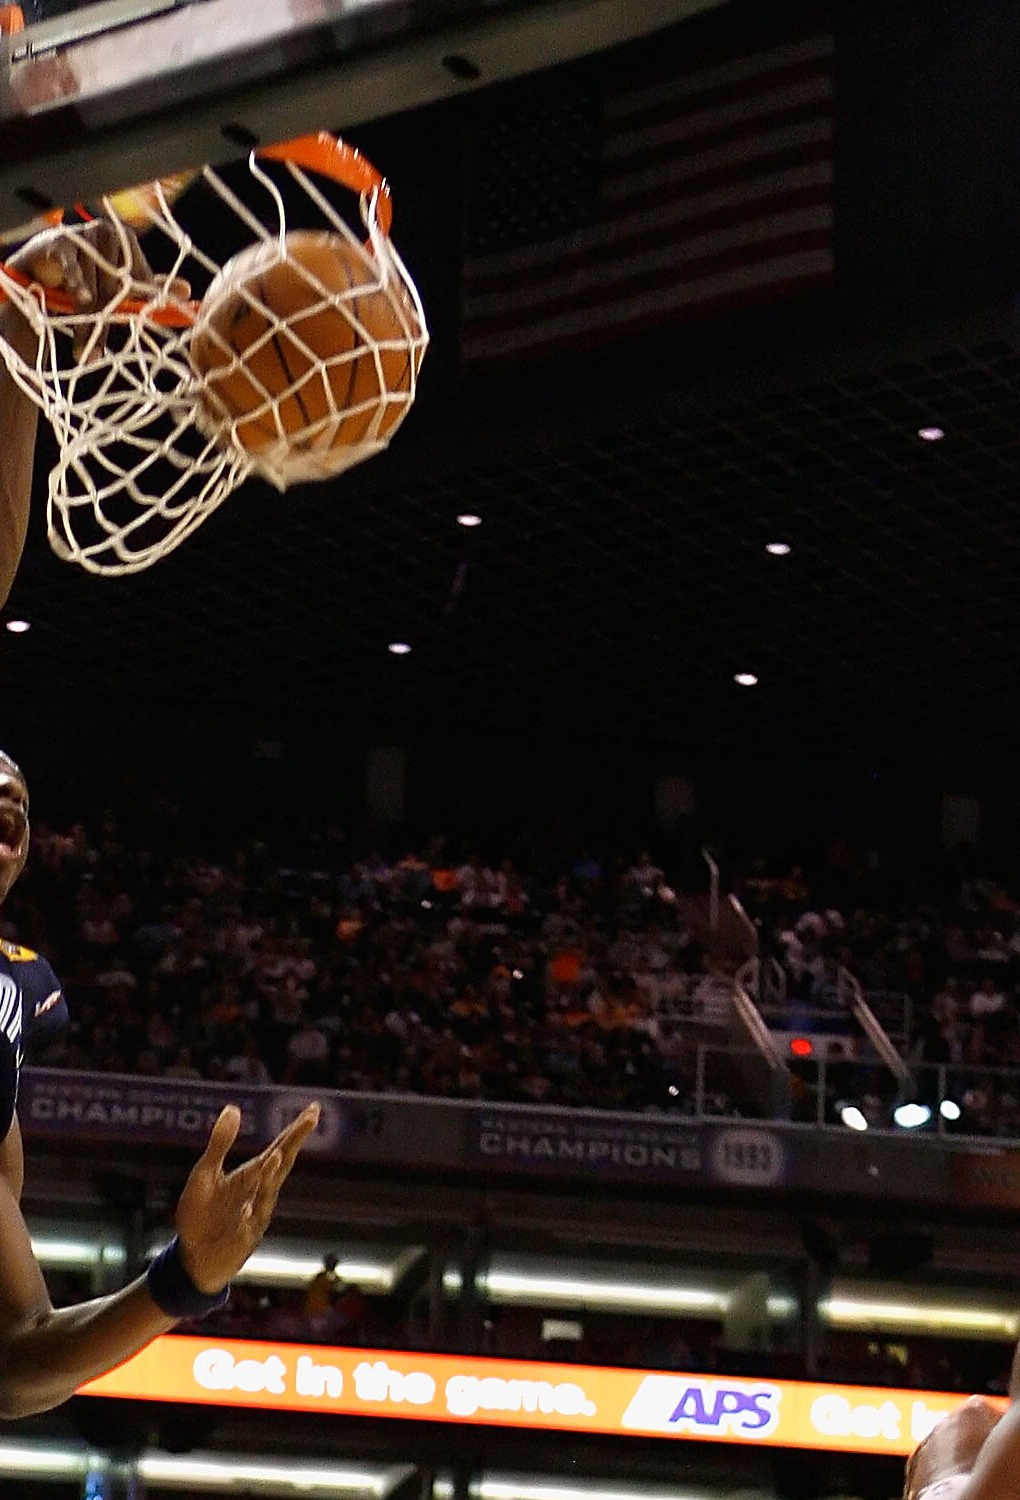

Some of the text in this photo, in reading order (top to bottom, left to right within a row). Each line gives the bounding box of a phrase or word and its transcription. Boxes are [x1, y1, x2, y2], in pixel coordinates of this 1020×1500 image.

[479, 1132, 702, 1170] CHAMPIONS
[192, 1347, 598, 1418] Get in the game.
[668, 1386, 774, 1431] APS
[810, 1394, 901, 1440] Get
